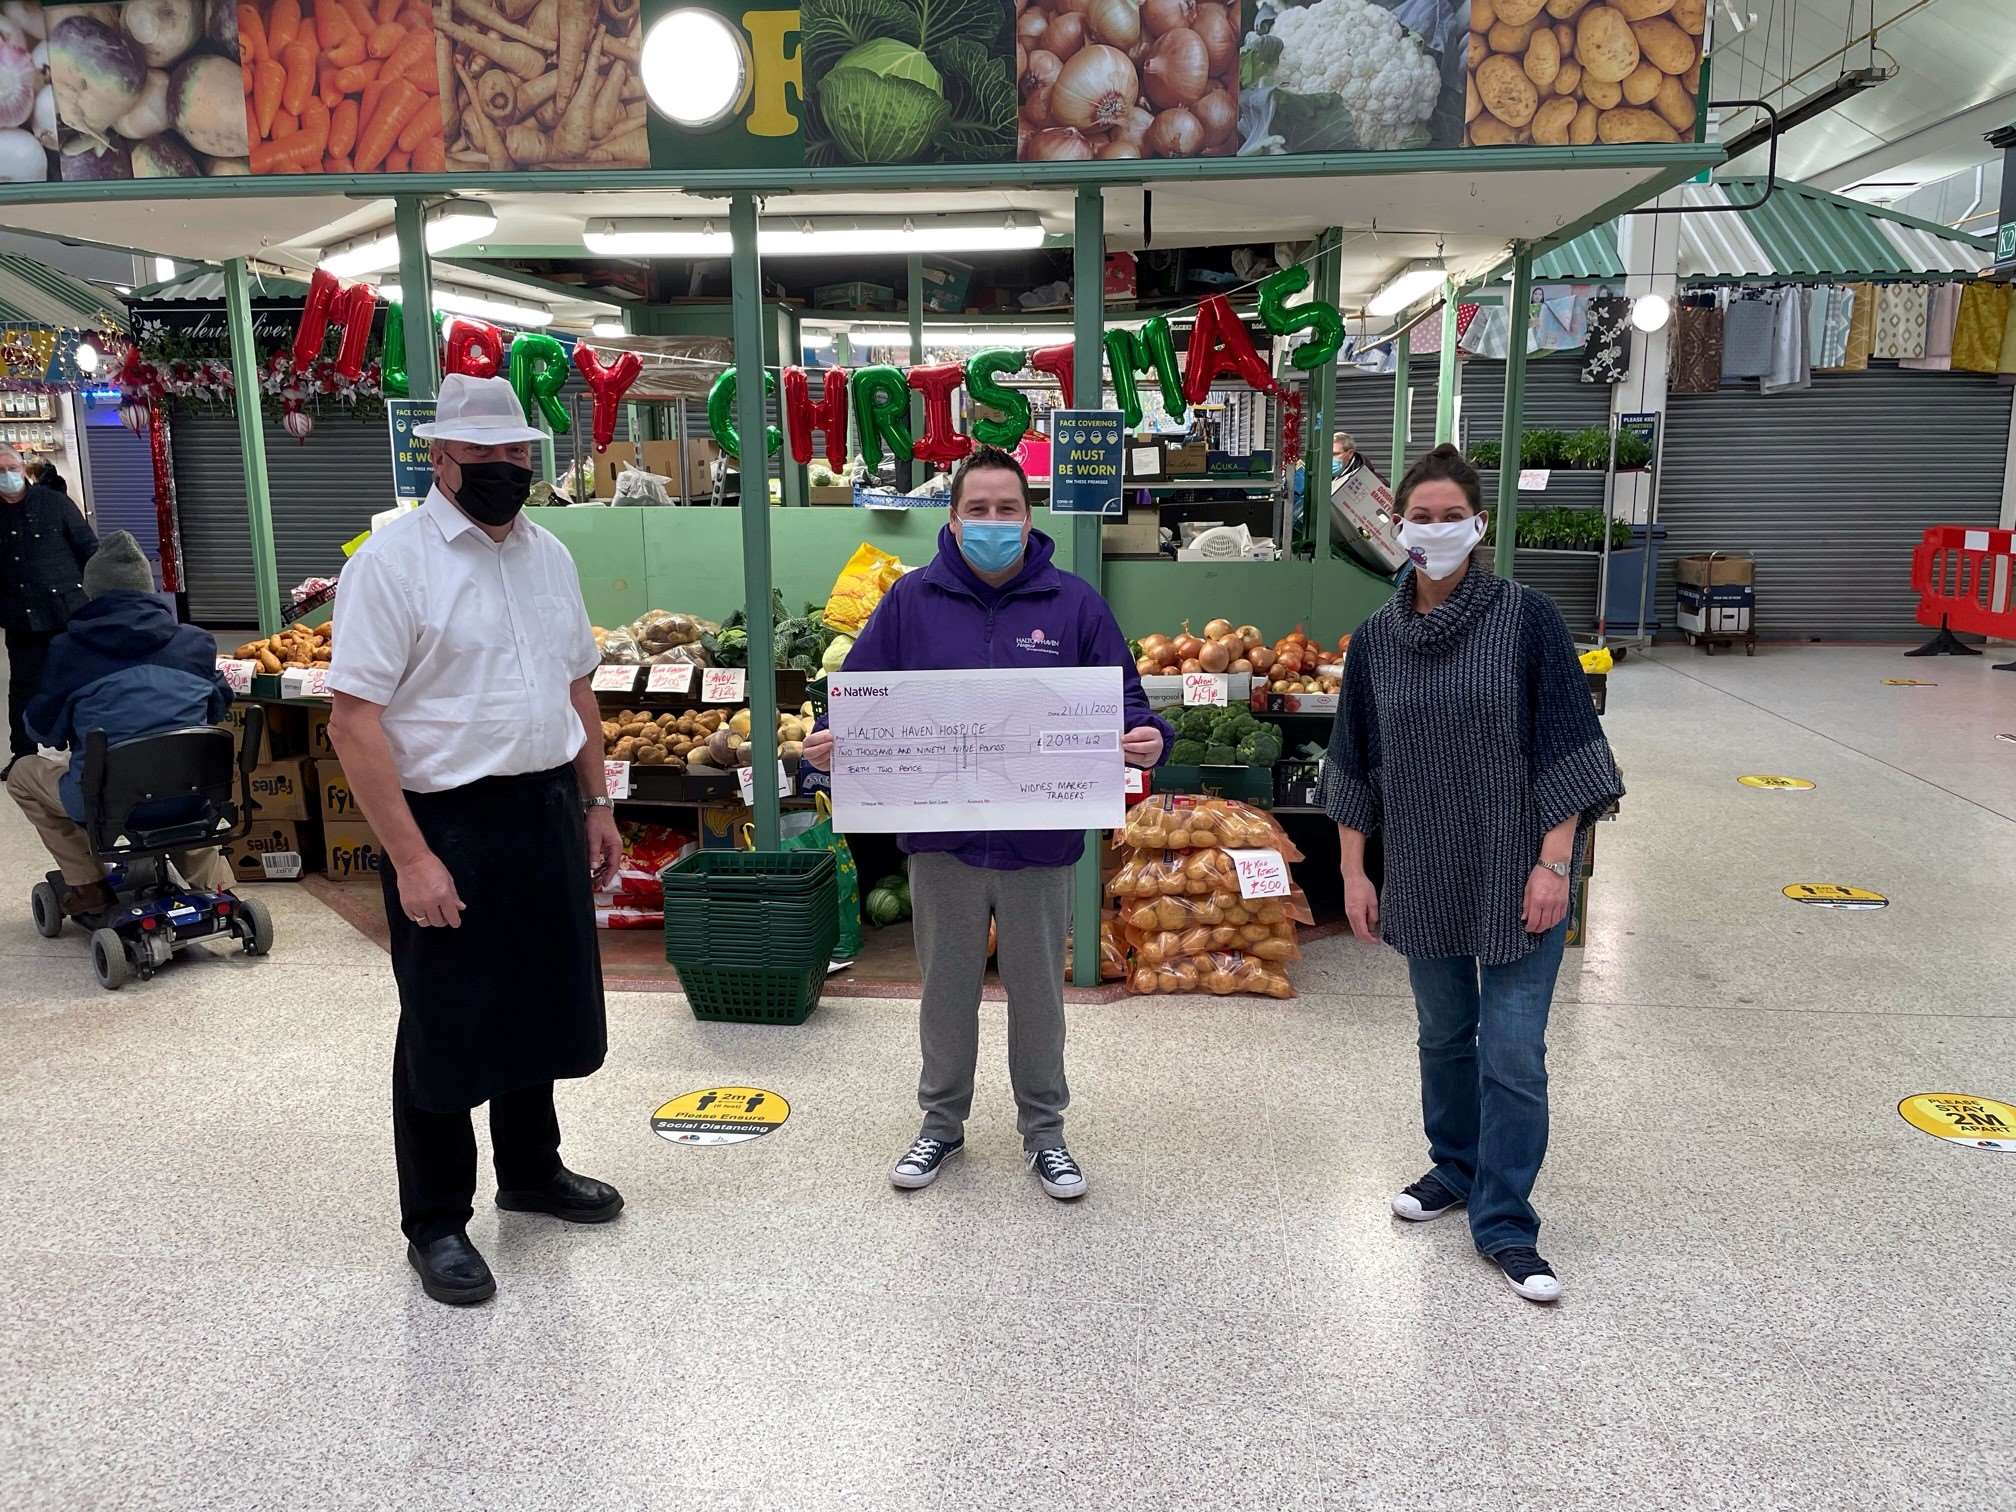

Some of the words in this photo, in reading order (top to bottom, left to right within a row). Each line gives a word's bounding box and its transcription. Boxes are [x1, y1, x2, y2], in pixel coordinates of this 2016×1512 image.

[1077, 420, 1117, 428] COVERINGS
[409, 438, 433, 448] MUS
[399, 452, 413, 462] BE
[416, 452, 433, 462] WO
[1070, 449, 1106, 461] MUST
[1058, 464, 1073, 475] BE
[1076, 464, 1116, 476] WORN
[844, 686, 889, 697] NatWest
[1148, 691, 1180, 702] mergosol
[1061, 702, 1118, 717] 21/11/2020
[847, 727, 895, 740] HALTON
[902, 725, 933, 737] HAVEN
[939, 722, 988, 736] HOSPICE
[838, 746, 853, 756] TWO
[856, 747, 893, 756] THOUSAND
[916, 745, 946, 753] NINETY
[1020, 782, 1052, 793] WIDNES
[1057, 781, 1099, 790] MARKET
[1047, 791, 1086, 801] TRADERS
[332, 844, 381, 876] fyffe
[722, 1093, 747, 1101] 2m
[1927, 1098, 1981, 1106] PLEASE
[1935, 1104, 1985, 1113] STAY
[675, 1111, 717, 1119] Please
[719, 1112, 766, 1122] Ensure
[1945, 1112, 2007, 1127] 2M
[656, 1121, 697, 1130] Social
[699, 1123, 769, 1134] Distancing
[1960, 1125, 2011, 1133] APART
